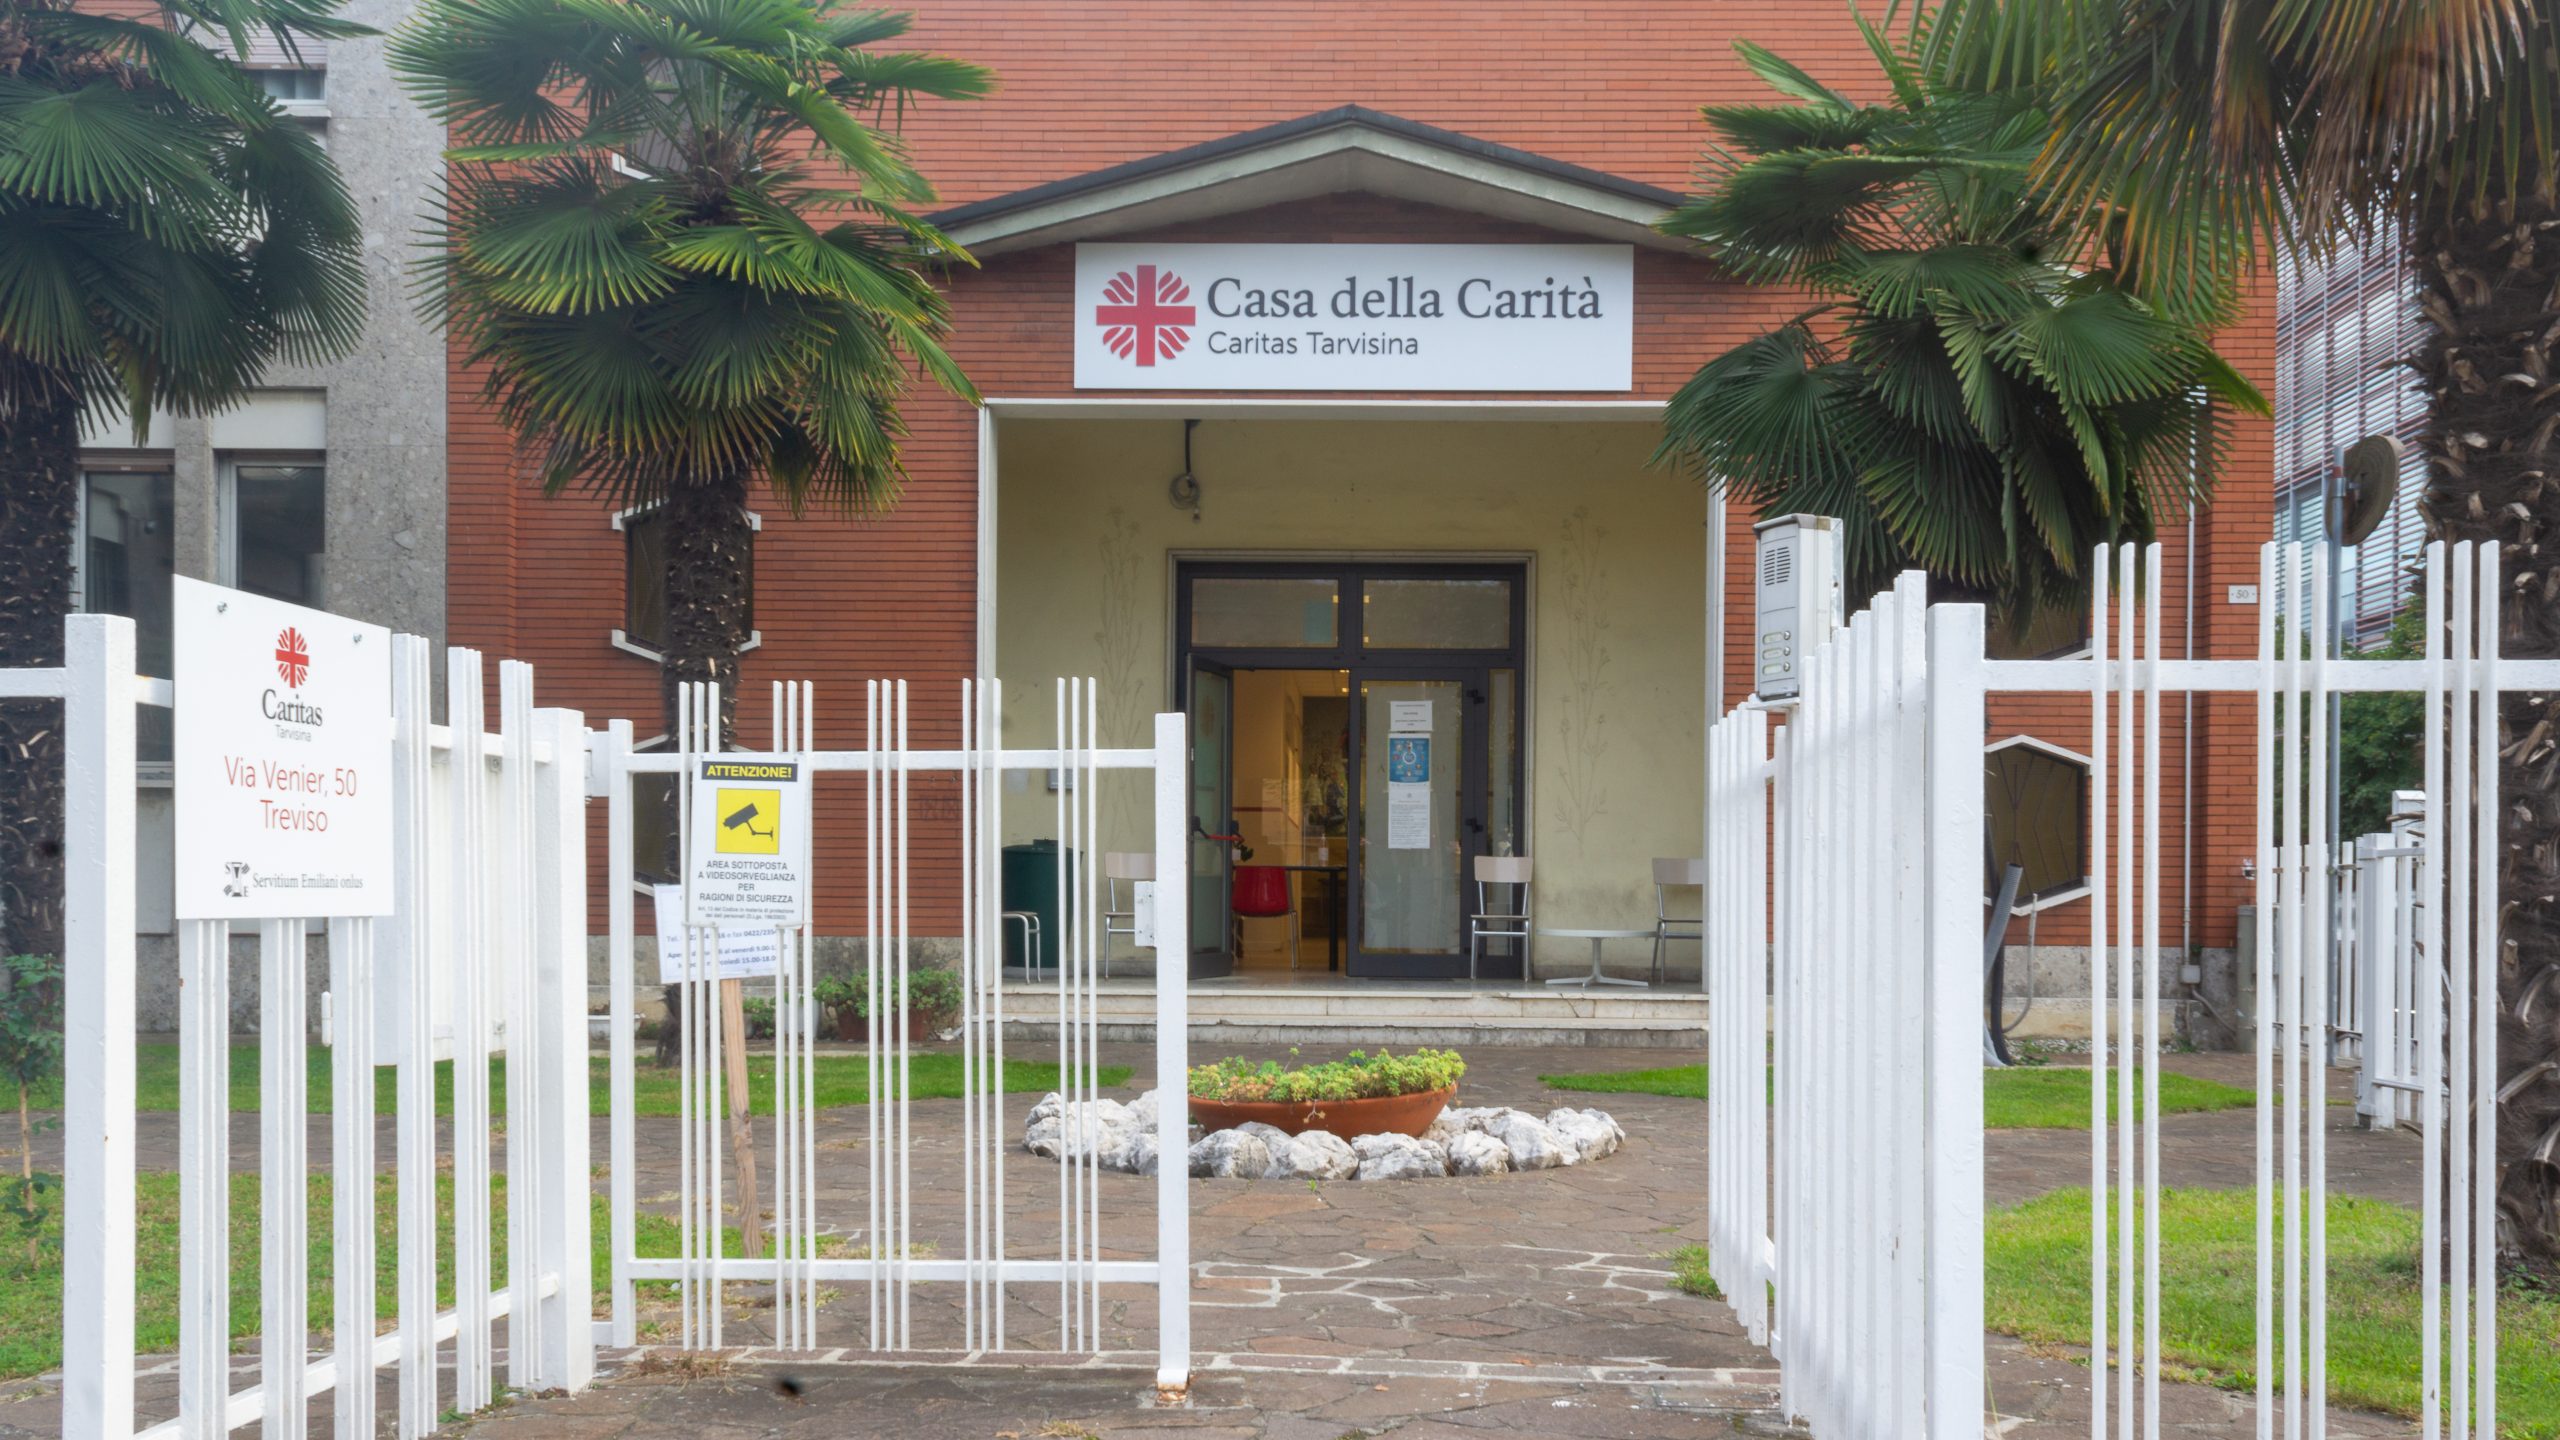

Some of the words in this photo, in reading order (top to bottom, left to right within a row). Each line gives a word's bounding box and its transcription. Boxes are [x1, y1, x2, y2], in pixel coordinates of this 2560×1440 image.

[1207, 277, 1317, 319] Casa
[1330, 276, 1444, 319] della
[1457, 276, 1603, 320] Carità
[1207, 332, 1298, 355] Caritas
[1306, 332, 1419, 355] Tarvisina
[262, 688, 323, 726] Caritas
[275, 724, 312, 743] Tarvisina
[224, 755, 256, 788] Via
[263, 759, 328, 798] Venier,
[334, 768, 358, 797] 50
[706, 764, 792, 779] ATTENZIONE!
[259, 799, 328, 832] Treviso
[706, 860, 729, 868] AREA
[731, 861, 788, 870] SOTTOPOSTA
[253, 873, 299, 888] Servitium
[301, 872, 338, 888] Emiliani
[340, 873, 363, 888] onlus
[698, 871, 704, 879] A
[706, 871, 796, 881] VIDEOSORVEGLIANZA
[738, 883, 755, 891] PER
[699, 892, 734, 901] RAGIONI
[736, 894, 744, 902] DI
[746, 894, 793, 903] SICUREZZA
